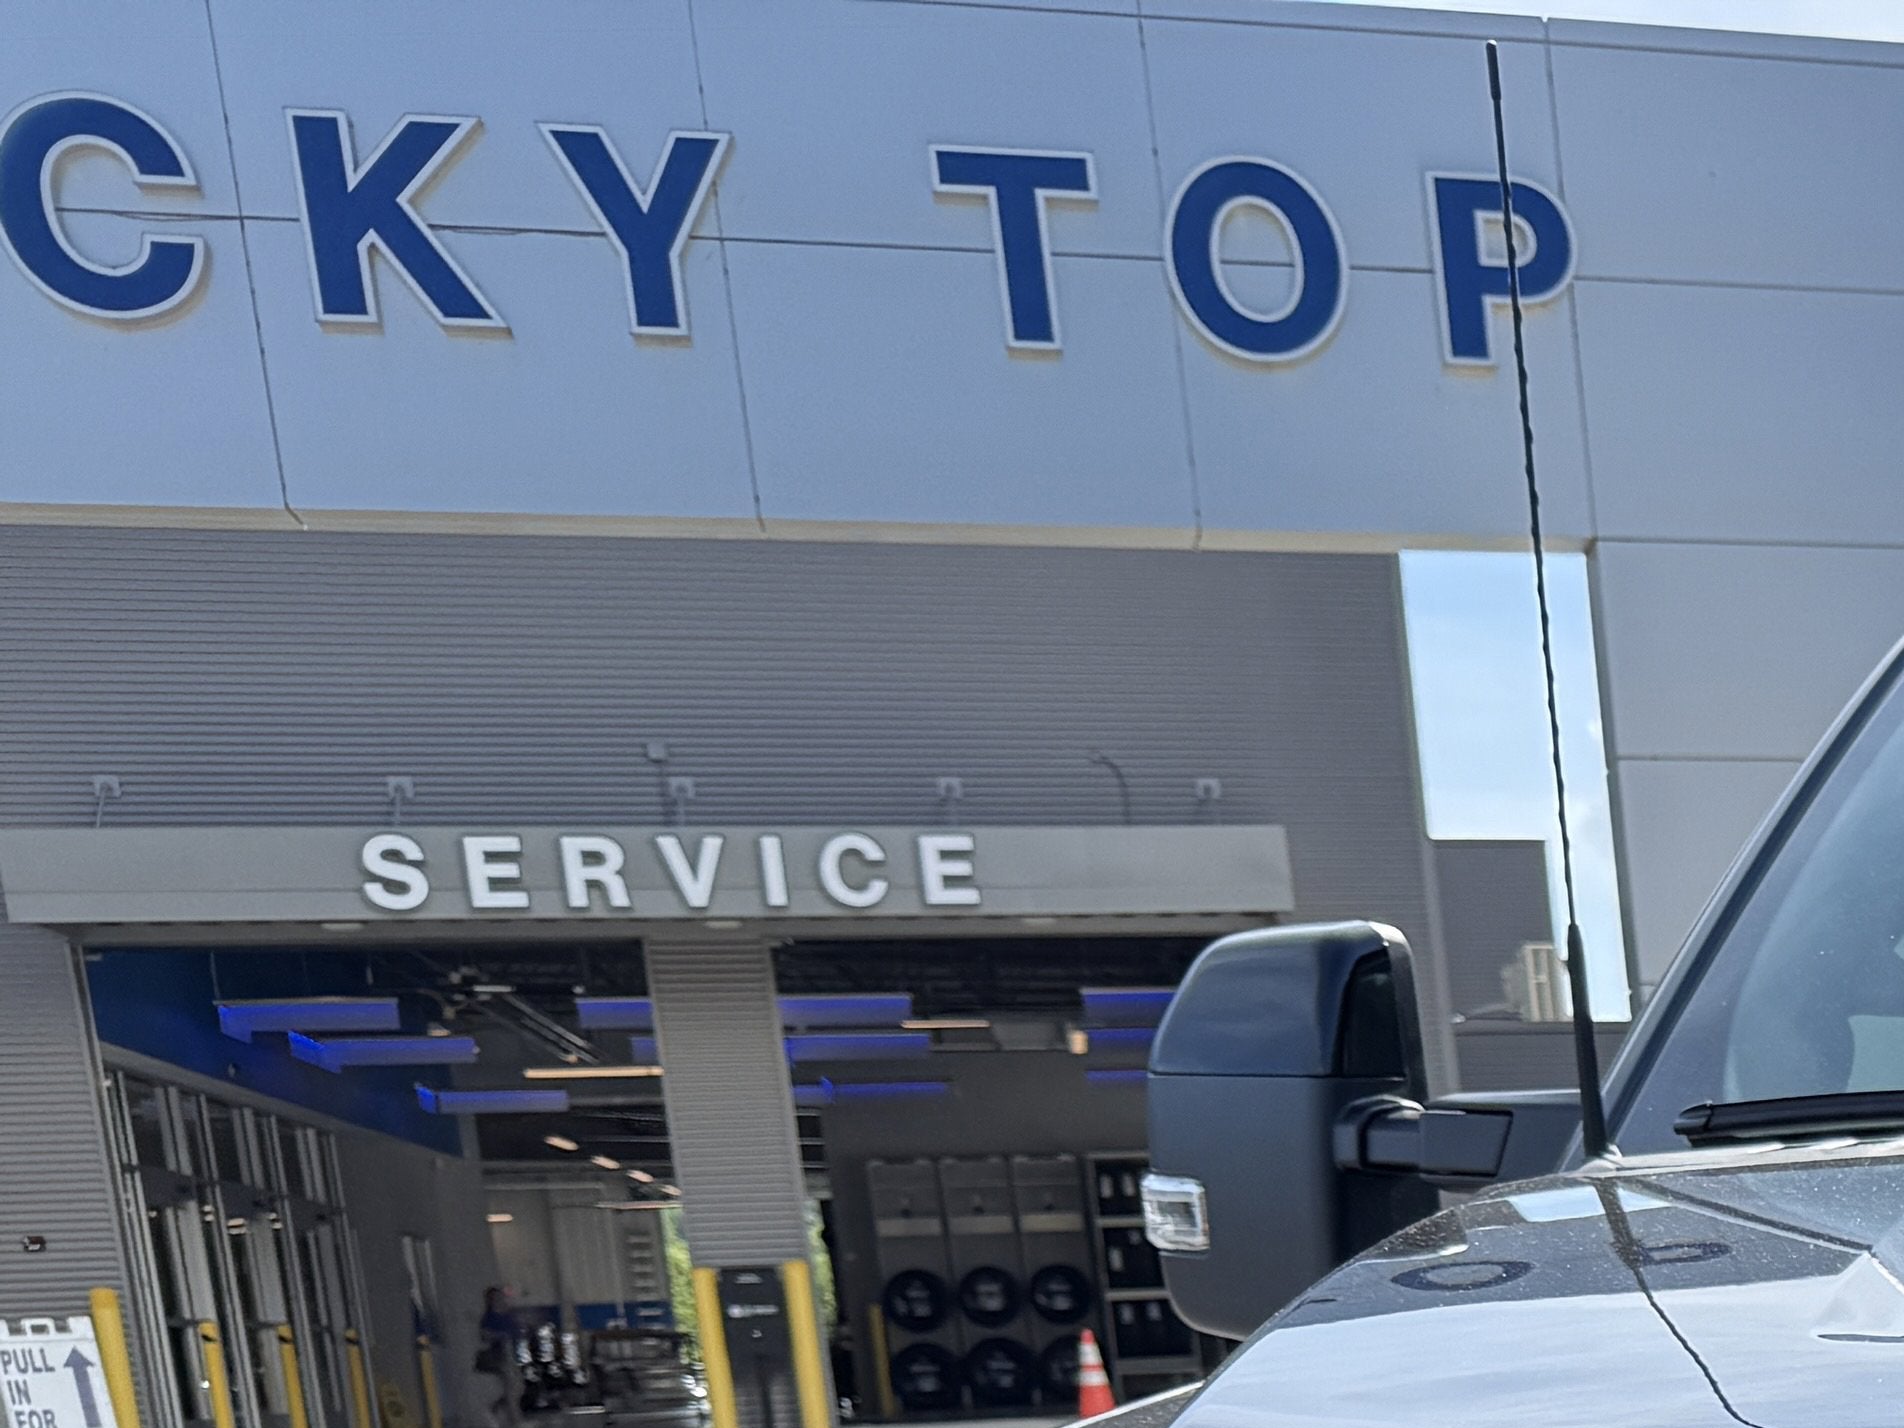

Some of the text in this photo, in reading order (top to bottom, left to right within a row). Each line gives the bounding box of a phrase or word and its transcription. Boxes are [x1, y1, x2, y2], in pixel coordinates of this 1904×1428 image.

[0, 91, 1576, 369] CKY TOP
[360, 833, 983, 910] SERVICE
[1, 1347, 56, 1375] PULL
[7, 1379, 32, 1405] IN
